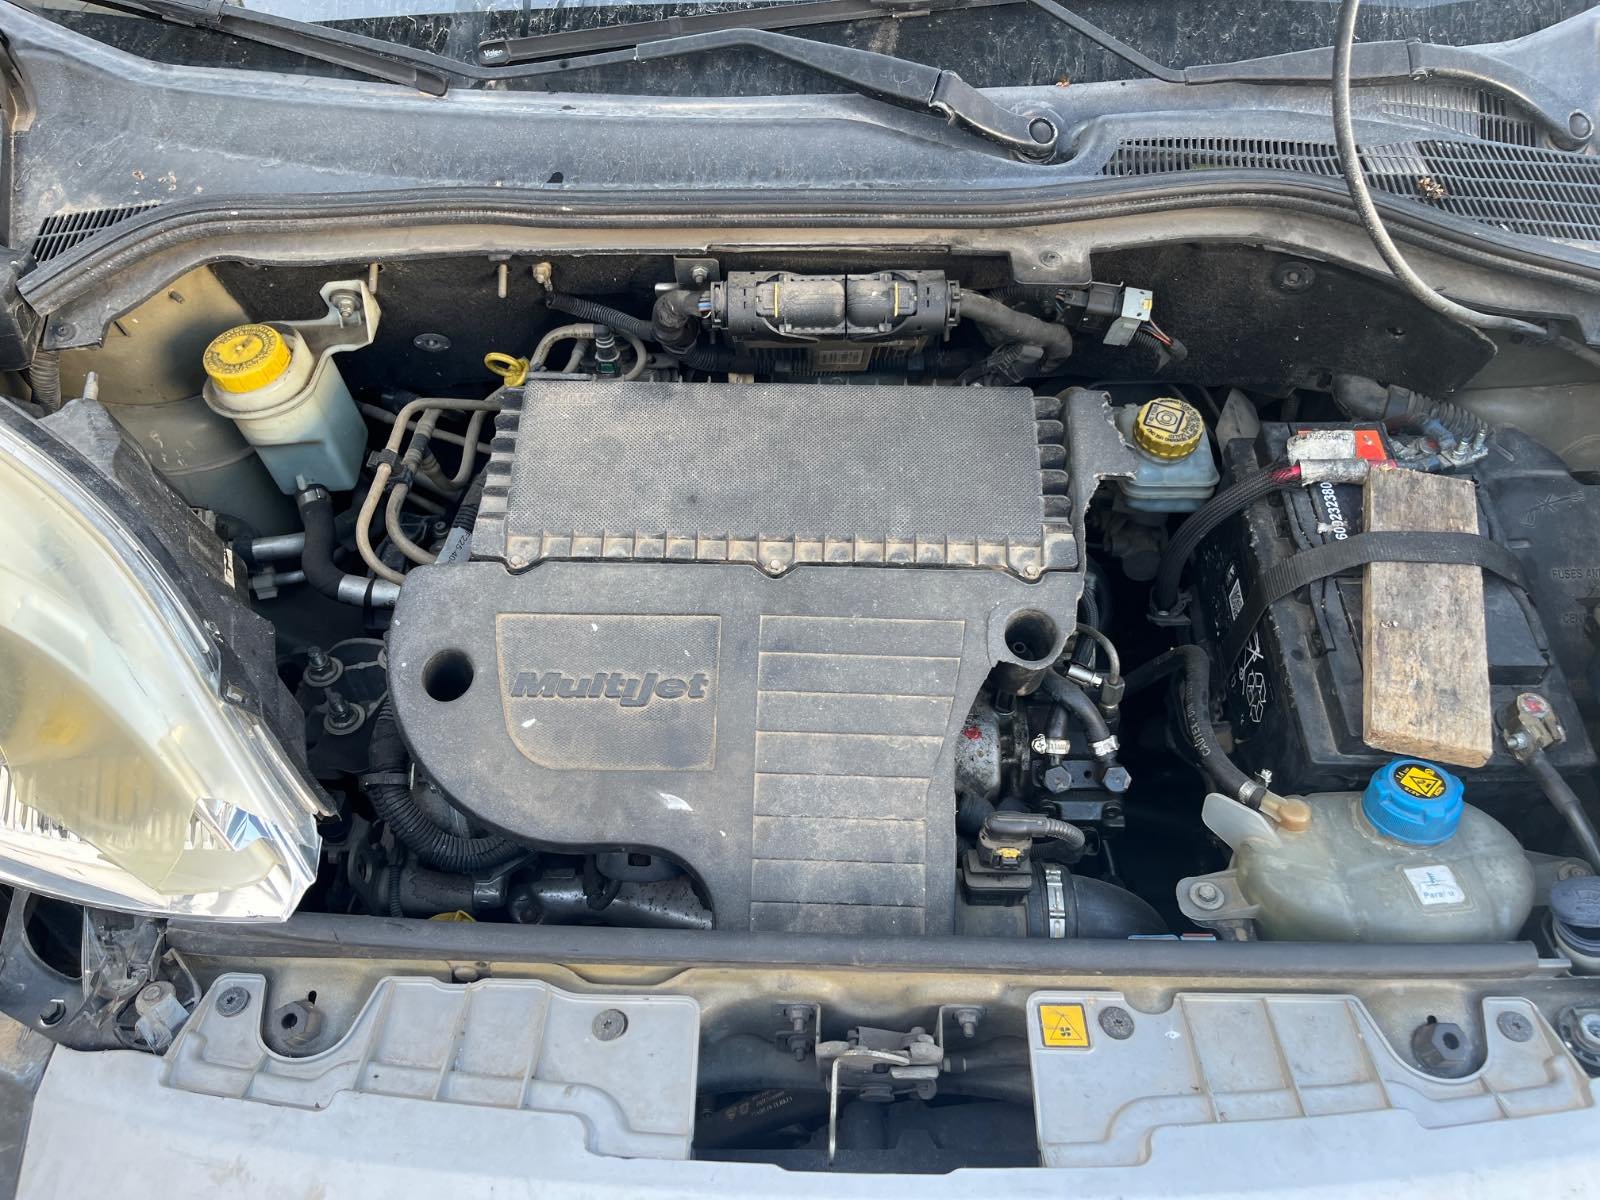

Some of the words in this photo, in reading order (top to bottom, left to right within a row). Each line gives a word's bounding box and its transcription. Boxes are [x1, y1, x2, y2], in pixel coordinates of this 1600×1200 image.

[1320, 482, 1349, 541] 600232380
[1552, 568, 1582, 579] FUSES
[1587, 568, 1600, 577] AN
